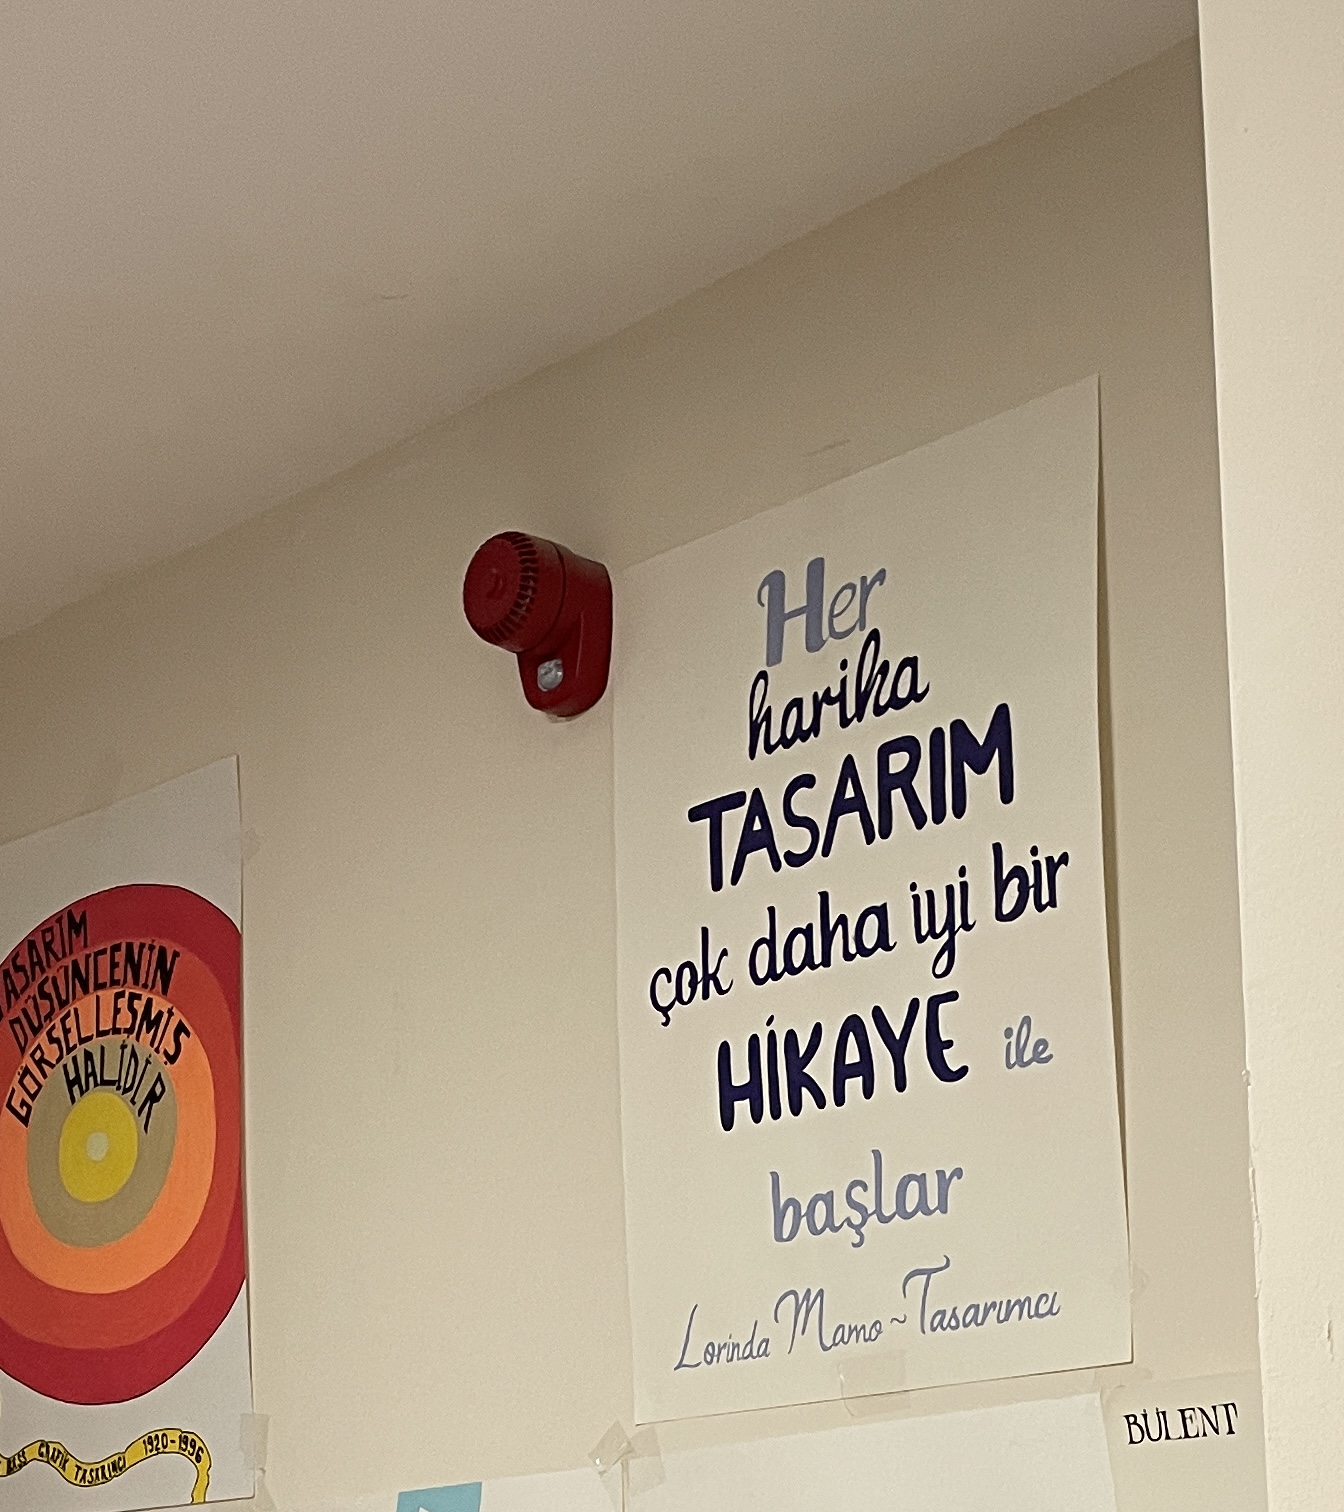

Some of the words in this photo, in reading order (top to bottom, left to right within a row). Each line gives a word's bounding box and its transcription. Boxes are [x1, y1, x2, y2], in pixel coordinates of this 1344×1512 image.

[757, 557, 887, 667] Her
[748, 628, 930, 760] harika
[687, 702, 1015, 893] TASARIM
[649, 926, 733, 1026] çok
[748, 890, 897, 986] daha
[909, 865, 977, 979] iyi
[991, 841, 1069, 923] bir
[5, 989, 191, 1128] GÖRSELLEŞMİŞ
[62, 1039, 166, 1135] HALİDİR
[716, 990, 970, 1132] HİKAYE
[1003, 1015, 1054, 1070] ile
[769, 1148, 964, 1248] başlar
[673, 1304, 771, 1371] Lorinda
[773, 1287, 883, 1355] Mamo
[901, 1255, 1061, 1335] Tasarımcı
[1122, 1402, 1239, 1446] BÜLENT
